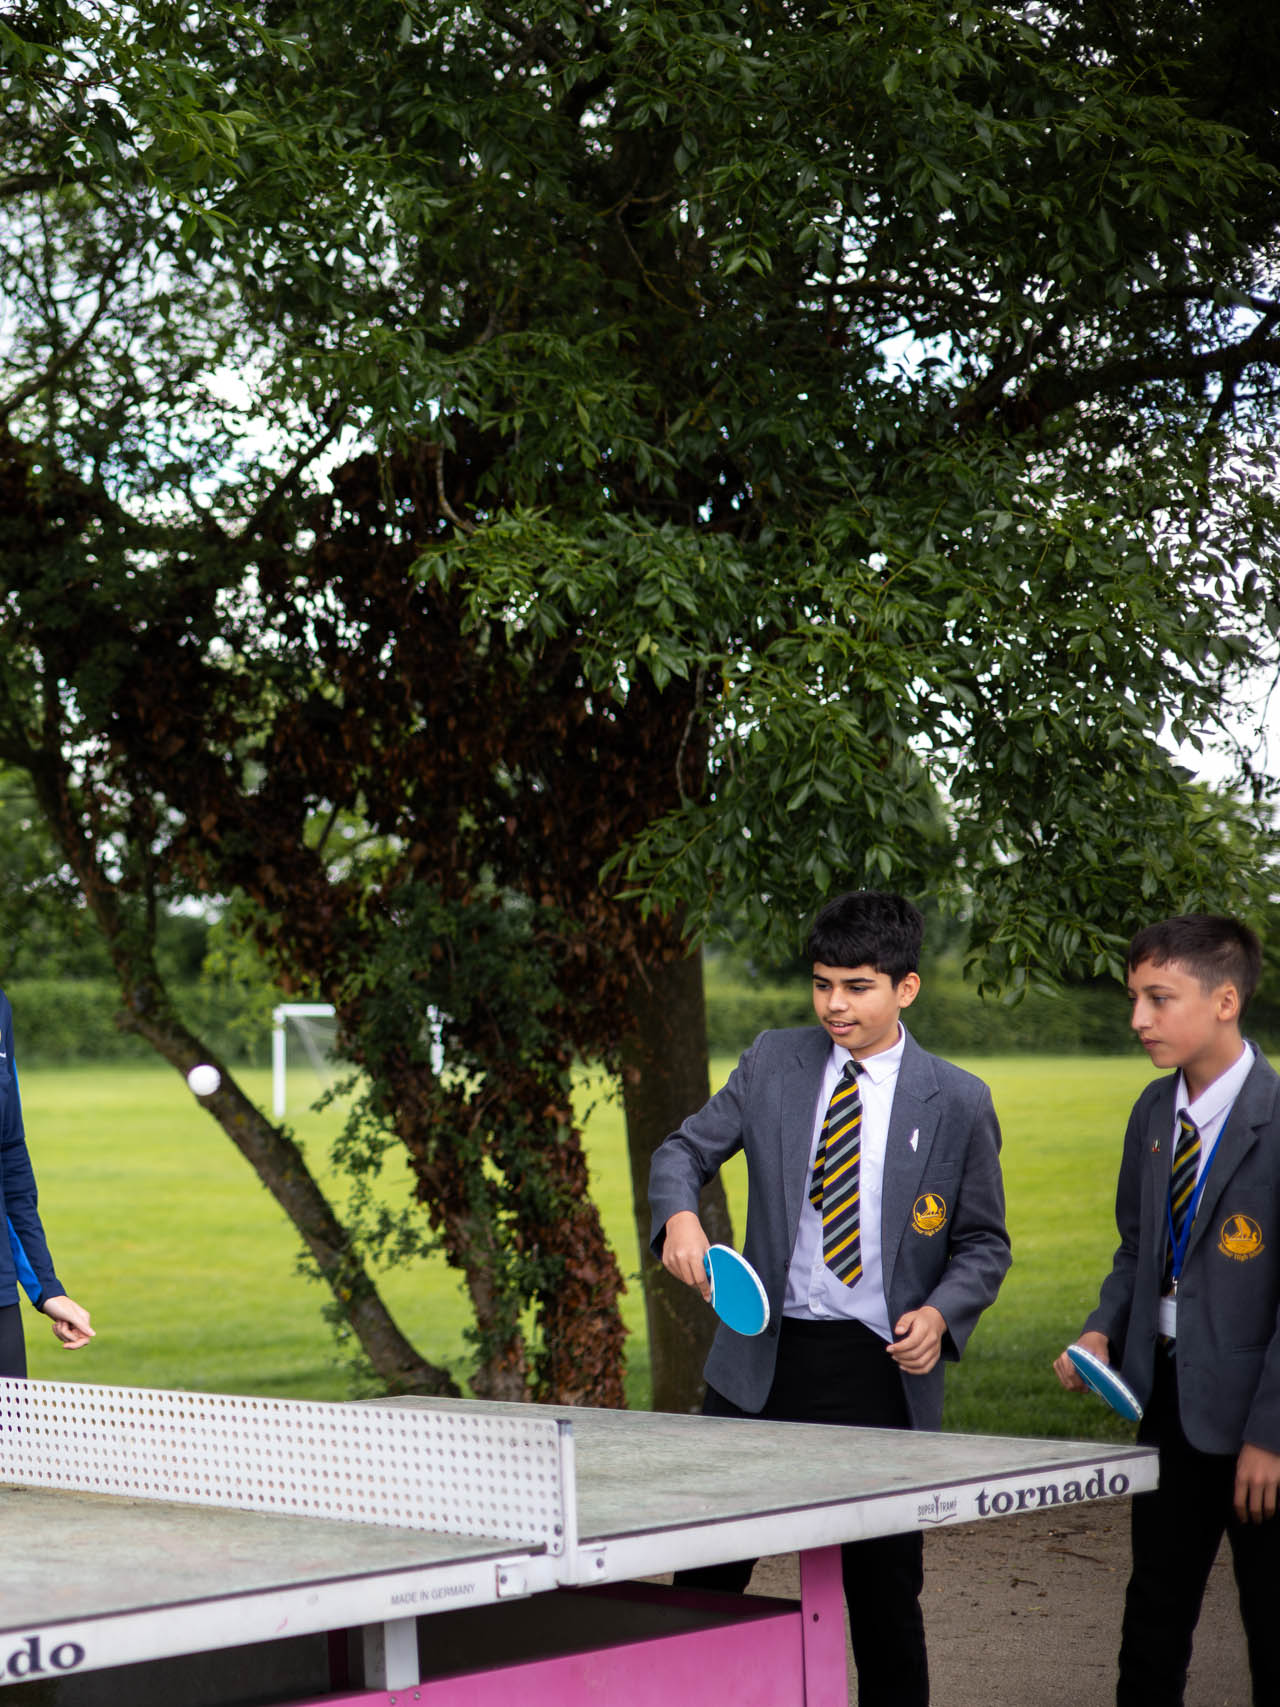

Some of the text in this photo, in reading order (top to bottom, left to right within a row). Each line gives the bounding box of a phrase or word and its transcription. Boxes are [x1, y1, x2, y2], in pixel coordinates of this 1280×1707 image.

[974, 1467, 1130, 1517] tornado
[917, 1497, 957, 1517] SUPER TRAMP
[391, 1583, 476, 1605] MADE IN GERMANY
